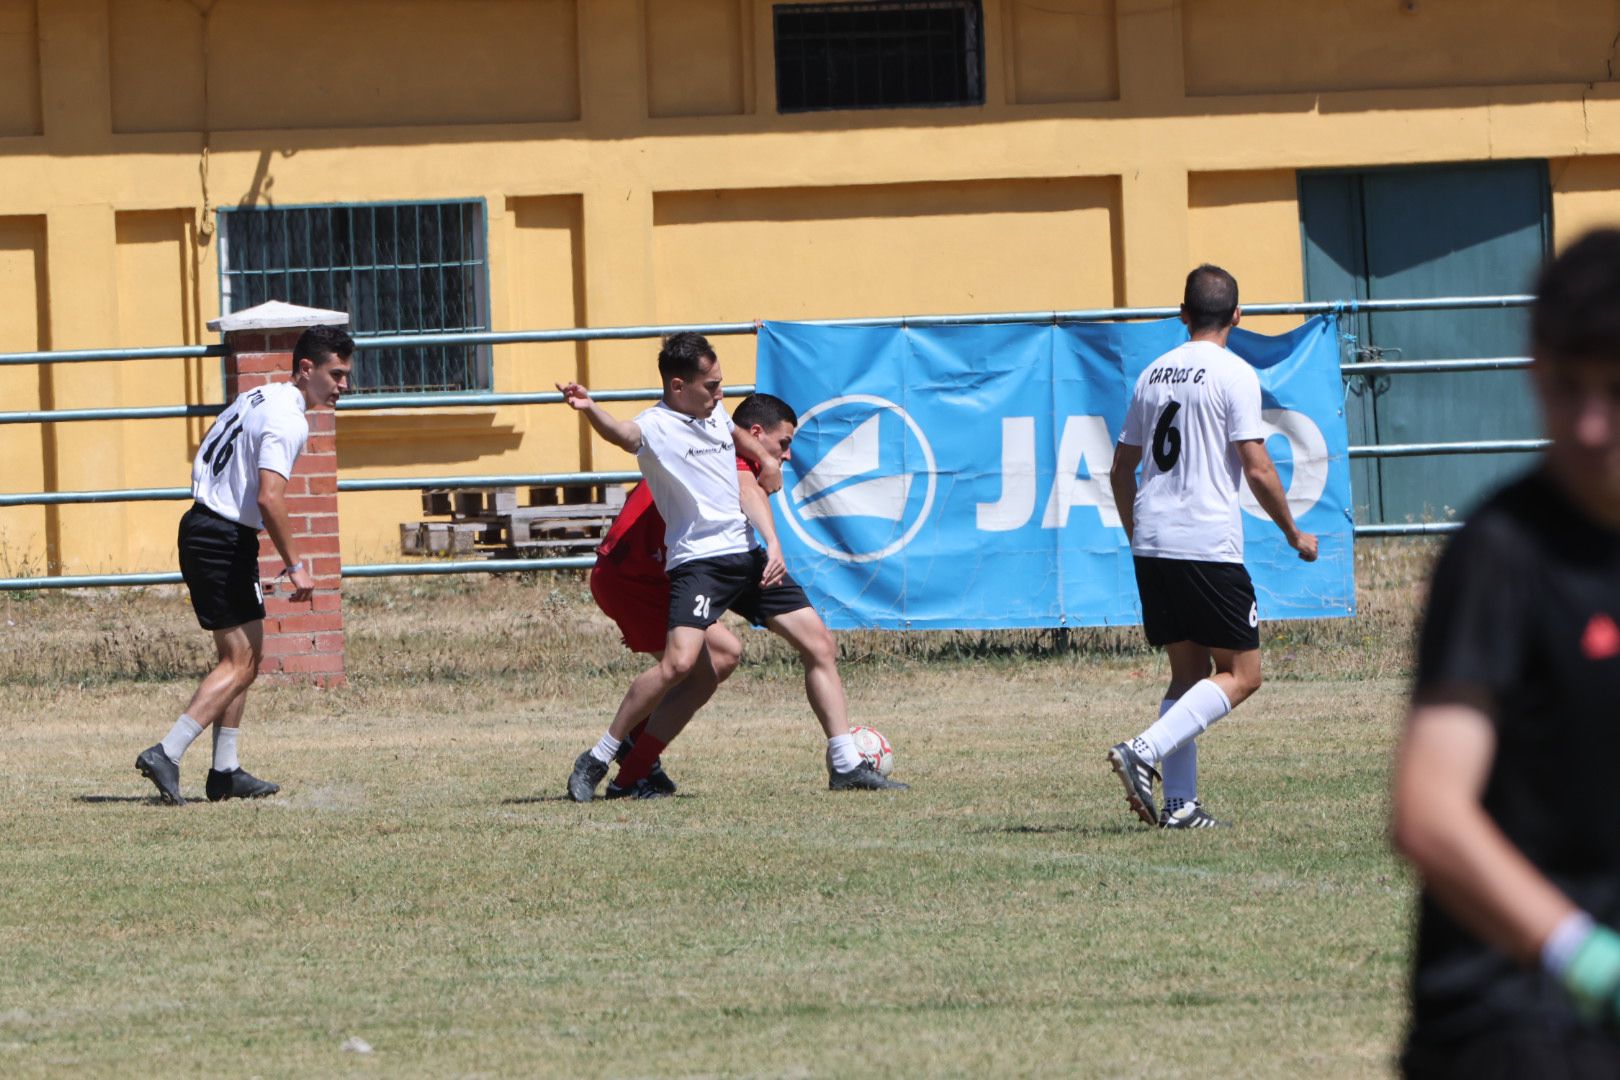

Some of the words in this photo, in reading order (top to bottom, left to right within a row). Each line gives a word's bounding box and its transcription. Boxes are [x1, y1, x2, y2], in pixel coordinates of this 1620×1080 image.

[1149, 367, 1193, 385] CARLOS
[1193, 368, 1206, 385] G.
[202, 412, 243, 477] 16
[1151, 400, 1182, 473] 6
[976, 408, 1328, 531] JAO
[1249, 601, 1258, 628] 6
